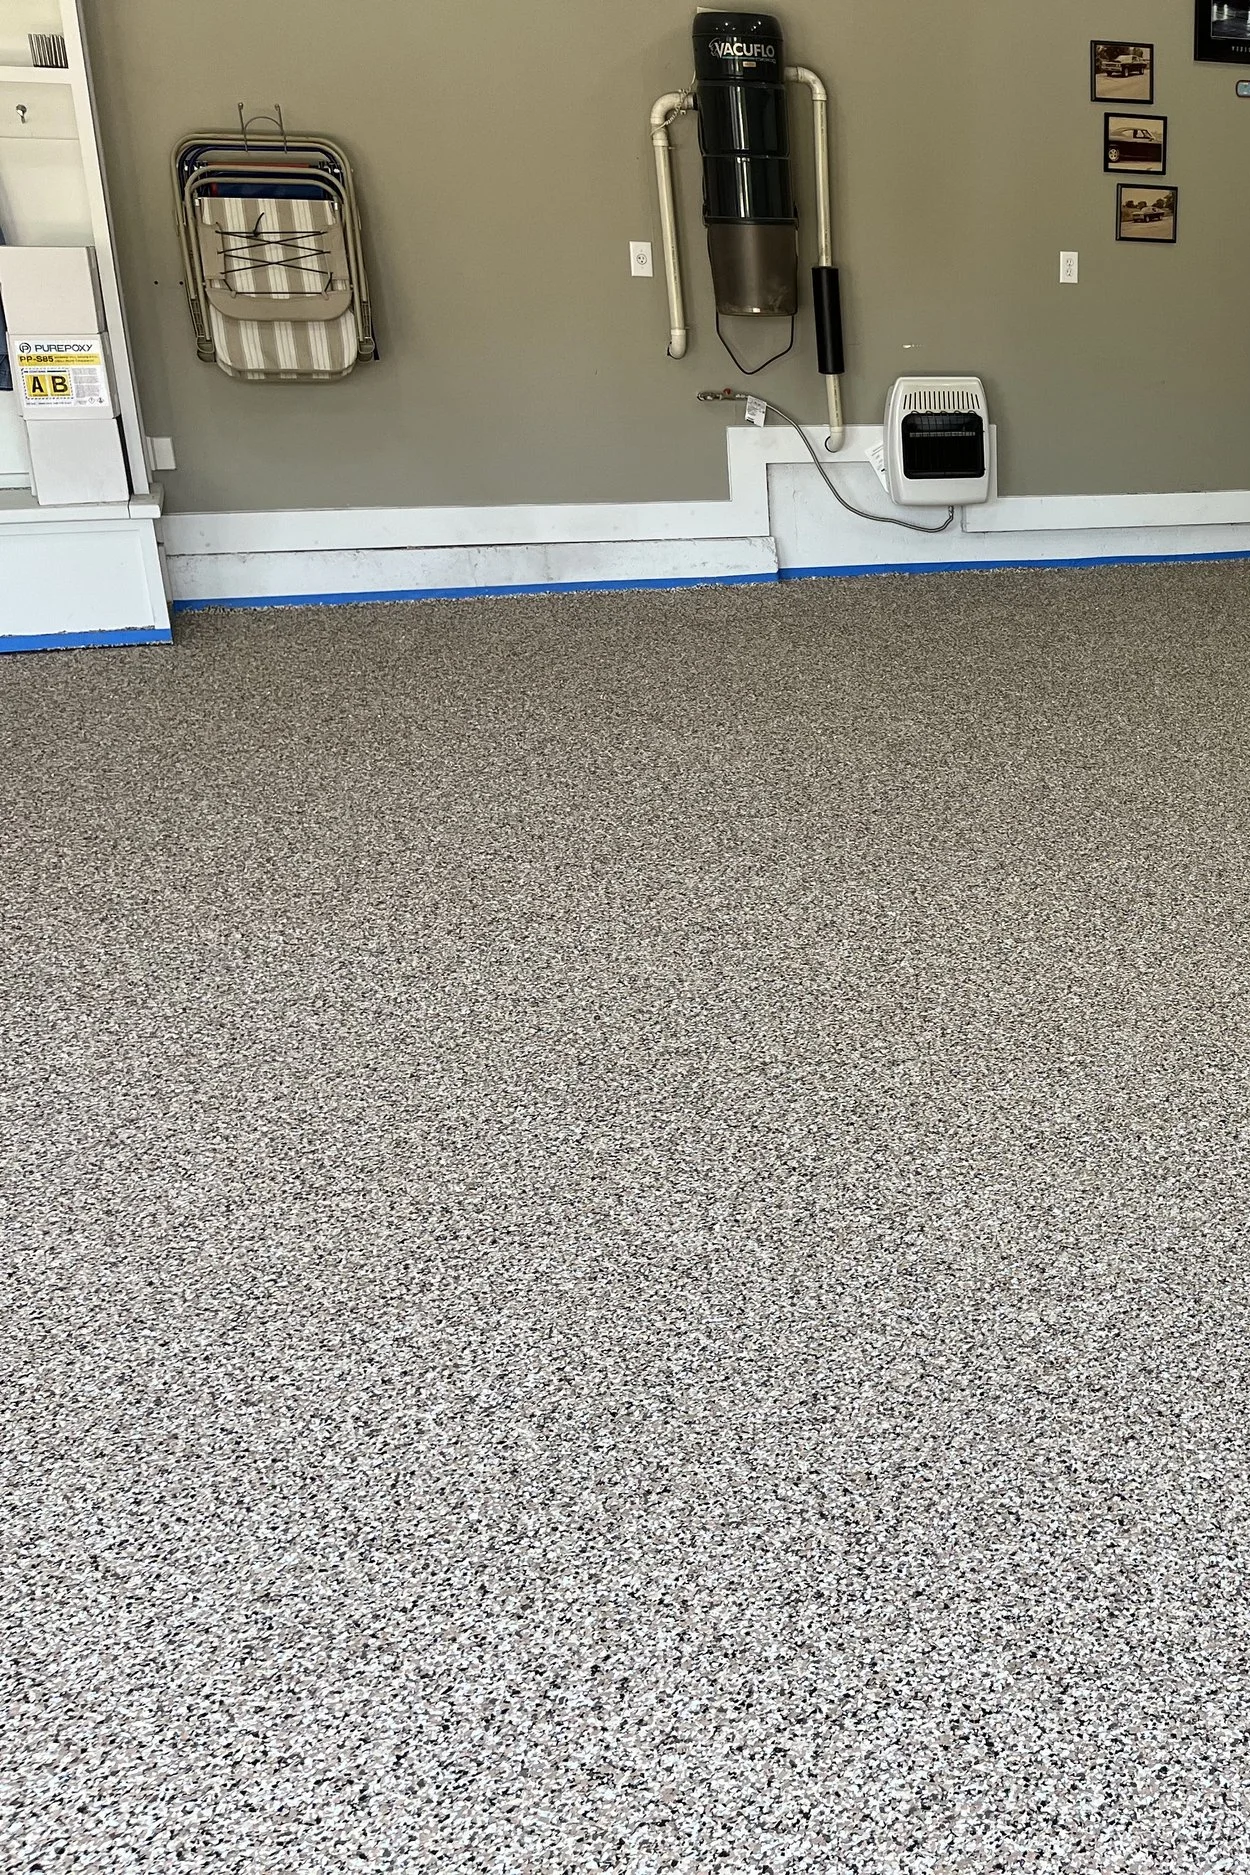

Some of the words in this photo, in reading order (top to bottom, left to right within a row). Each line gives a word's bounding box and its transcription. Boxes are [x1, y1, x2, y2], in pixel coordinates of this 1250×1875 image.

[714, 42, 775, 58] VACUFLO
[34, 344, 93, 353] PUREPOXY
[19, 355, 54, 363] PP-S85
[32, 376, 44, 393] A
[51, 375, 68, 393] B
